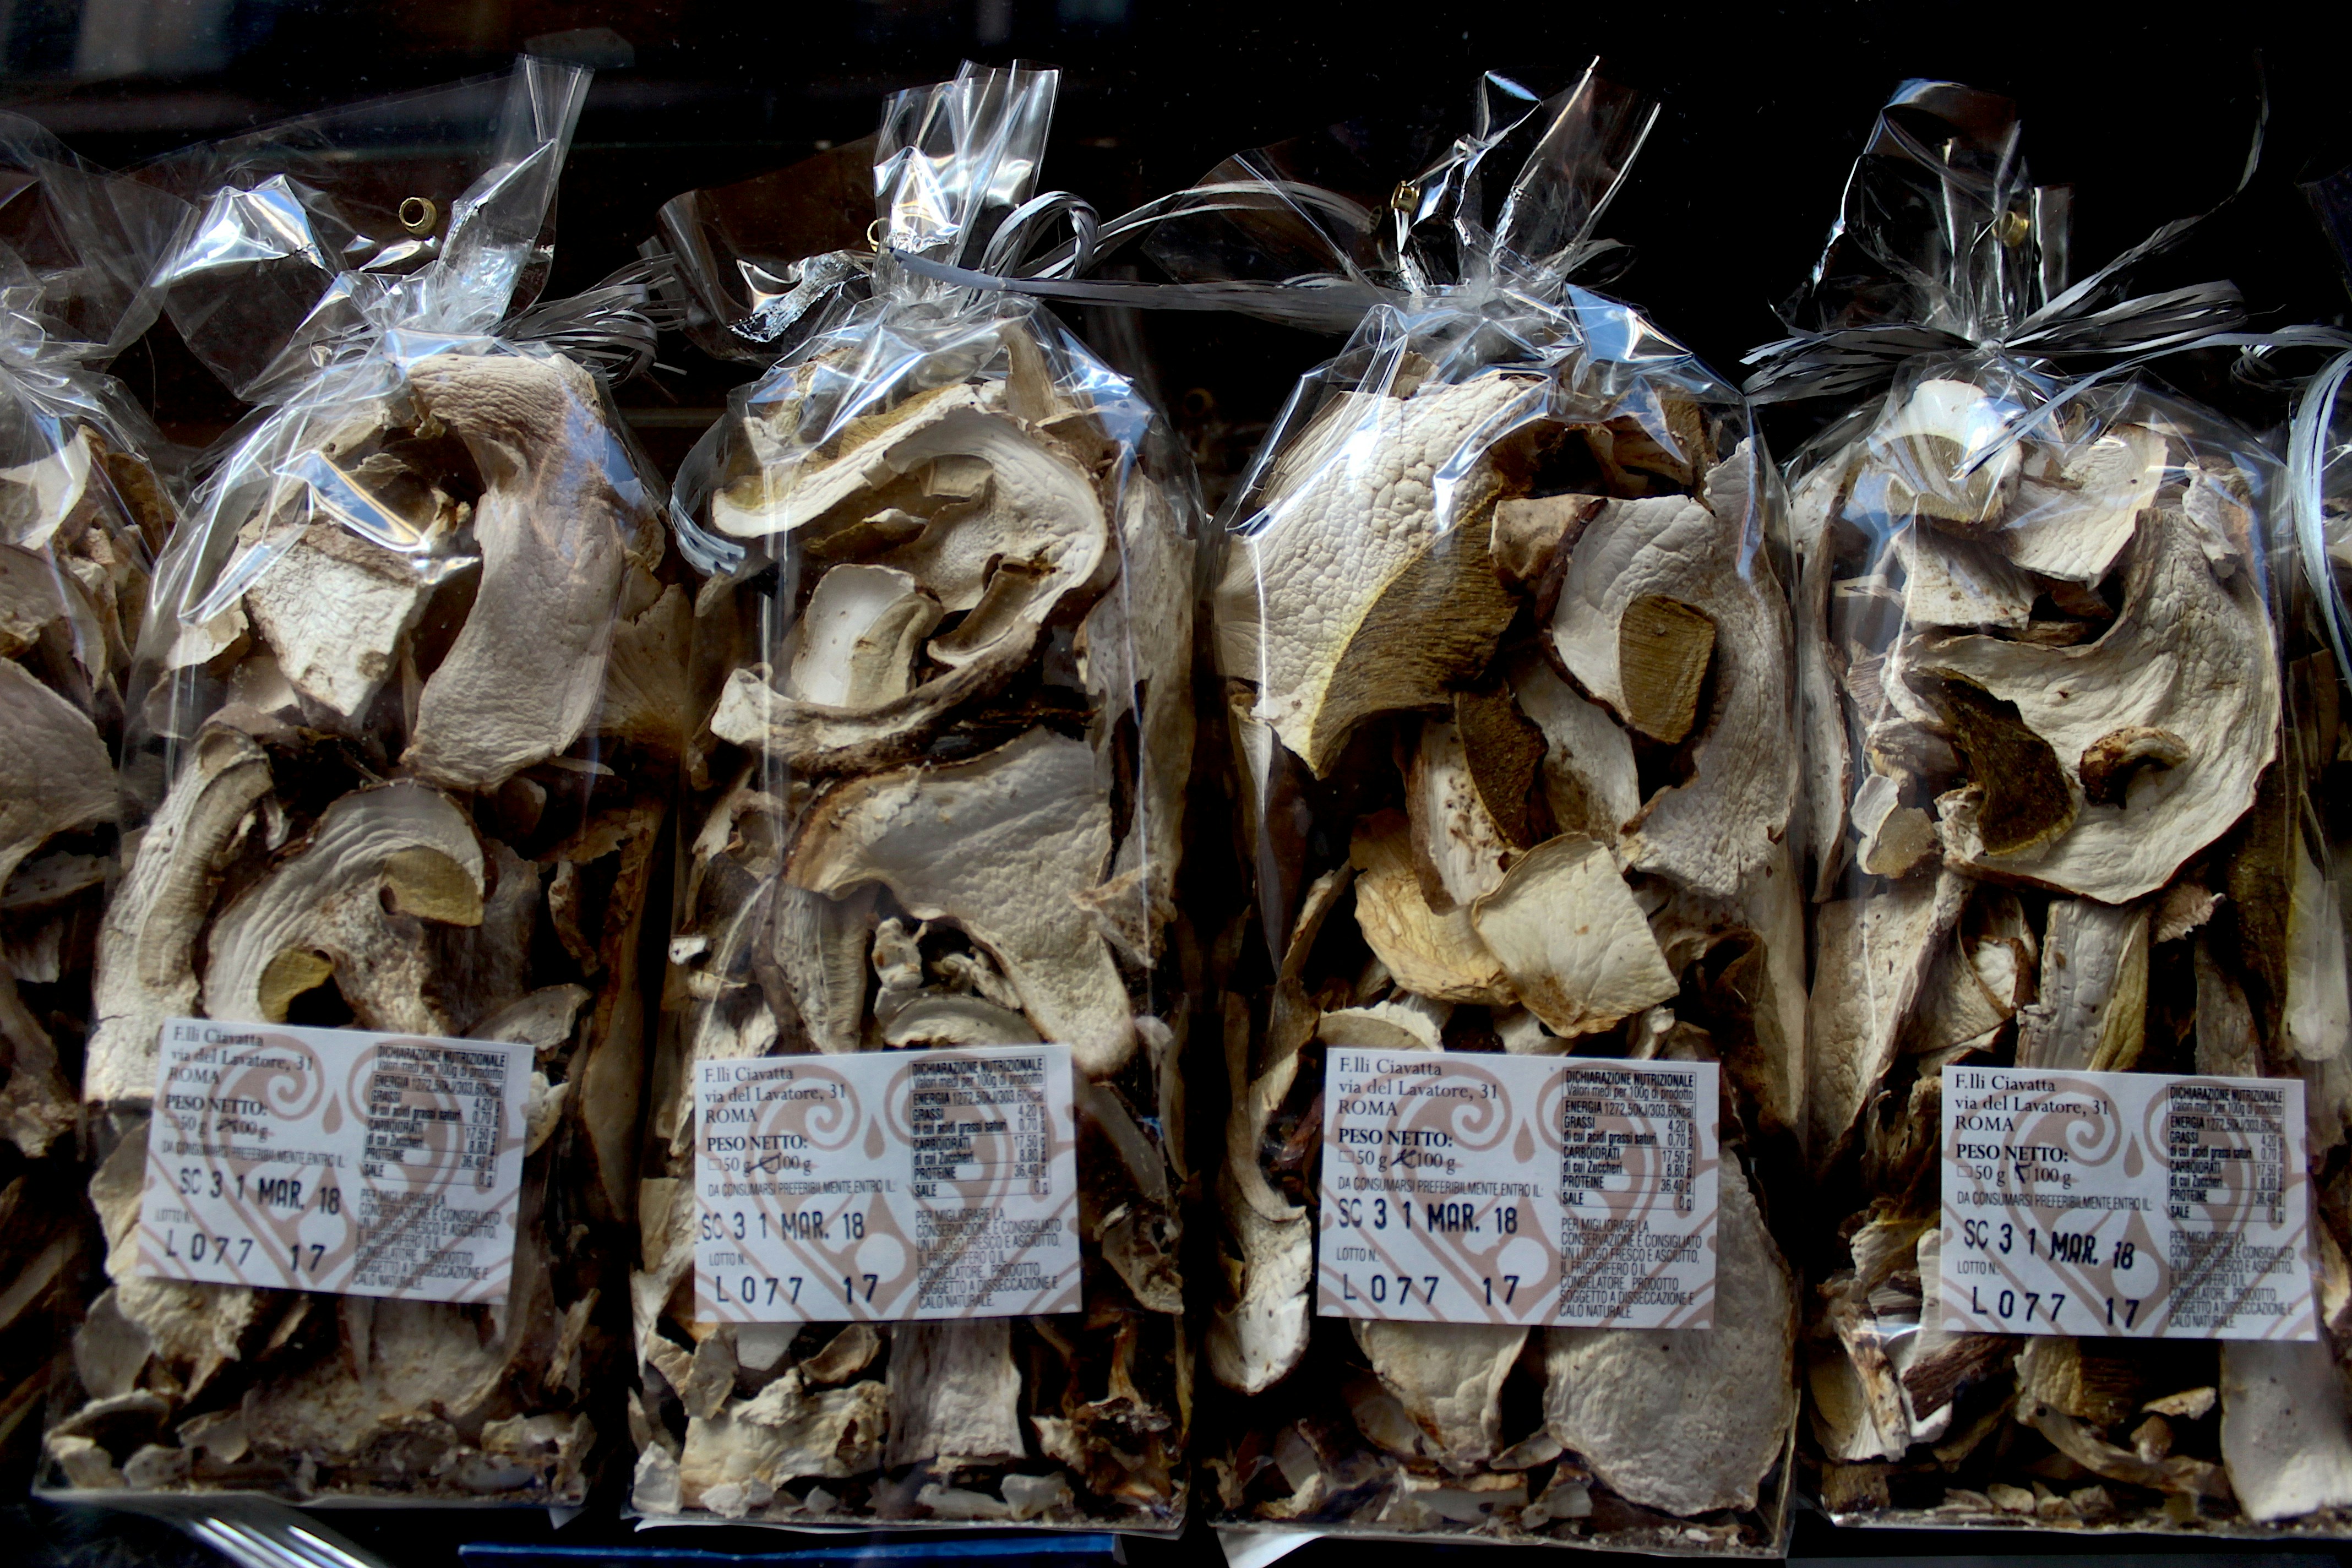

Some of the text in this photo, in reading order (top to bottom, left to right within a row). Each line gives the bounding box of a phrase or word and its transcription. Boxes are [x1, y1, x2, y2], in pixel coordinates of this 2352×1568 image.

[204, 1028, 264, 1046] Ciavatta
[171, 1050, 190, 1061] via
[194, 1047, 216, 1063] del
[297, 1055, 313, 1071] 31
[1340, 1057, 1442, 1075] F.lli Ciavatta
[167, 1067, 220, 1084] ROMA
[705, 1067, 793, 1082] F.lli Ciavatta
[1566, 1070, 1693, 1087] DICHIARAZIONE NUTRIZIONALE
[1956, 1074, 2056, 1091] F.lli Ciavatta
[705, 1084, 845, 1103] via del Lavatore, 31
[1339, 1079, 1497, 1101] via del Lavatore, 31
[1567, 1085, 1694, 1101] Valori medi per 100g di prodotto
[165, 1095, 268, 1115] PESO NETTO:
[1338, 1100, 1397, 1116] ROMA
[1566, 1101, 1602, 1114] ENERGIA
[1955, 1096, 2108, 1117] via del Lavatore, 31
[706, 1109, 758, 1123] ROMA
[1956, 1115, 2014, 1132] ROMA
[1564, 1117, 1693, 1135] GRASSI 4,20 g
[707, 1135, 808, 1151] PESO NETTO:
[1338, 1128, 1452, 1147] PESO NETTO:
[1564, 1129, 1693, 1150] di cui acidi grassi saturi 0,70 g
[1564, 1146, 1692, 1166] CARBOIDRATI 17,50 g
[1957, 1144, 2068, 1162] PESO NETTO:
[725, 1157, 739, 1172] 50
[777, 1155, 798, 1169] 100
[803, 1160, 812, 1176] g
[1357, 1151, 1455, 1175] 50 g 100 g
[1564, 1161, 1692, 1179] di cui Zuccheri 8,80 g
[1338, 1177, 1349, 1190] DA
[1354, 1177, 1414, 1193] CONSUMARSI
[1417, 1180, 1499, 1195] PREFERIBILMENTE
[1501, 1183, 1530, 1196] ENTRO
[1563, 1175, 1691, 1193] PROTEINE 36,40 g
[1975, 1166, 2071, 1190] 50 g 100 g
[179, 1167, 202, 1195] SC
[320, 1186, 340, 1215] 18
[708, 1184, 719, 1196] DA
[1562, 1192, 1691, 1211] SALE 0 g
[1958, 1191, 1970, 1204] DA
[1973, 1192, 2033, 1207] CONSUMARSI
[2114, 1197, 2140, 1211] ENTRO
[1338, 1199, 1362, 1228] SC
[1428, 1203, 1480, 1233] MAR.
[1495, 1207, 1517, 1234] 18
[1561, 1218, 1649, 1233] PER MIGLIORARE LA
[701, 1213, 723, 1240] SC
[781, 1212, 829, 1240] MAR.
[843, 1212, 864, 1239] 18
[1561, 1232, 1634, 1246] CONSERVAZIONE
[1645, 1234, 1702, 1248] CONSIGLIATO
[1964, 1219, 1988, 1250] SC
[2049, 1231, 2099, 1265] MAR.
[2113, 1242, 2135, 1270] 18
[291, 1244, 325, 1271] 17
[709, 1253, 736, 1266] LOTTO
[1337, 1248, 1366, 1261] LOTTO
[1561, 1247, 1574, 1259] UN
[1577, 1248, 1608, 1260] LUOGO
[1611, 1248, 1645, 1261] FRESCO
[1648, 1250, 1652, 1261] E
[1571, 1261, 1629, 1275] FRIGORIFERO
[1958, 1261, 1986, 1274] LOTTO
[844, 1275, 878, 1304] 17
[1483, 1276, 1519, 1306] 17
[1632, 1277, 1679, 1291] PRODOTTO
[1560, 1289, 1694, 1305] SOGGETTO A DISSECCAZIONE E
[1560, 1304, 1583, 1317] CALO
[2106, 1298, 2139, 1329] 17
